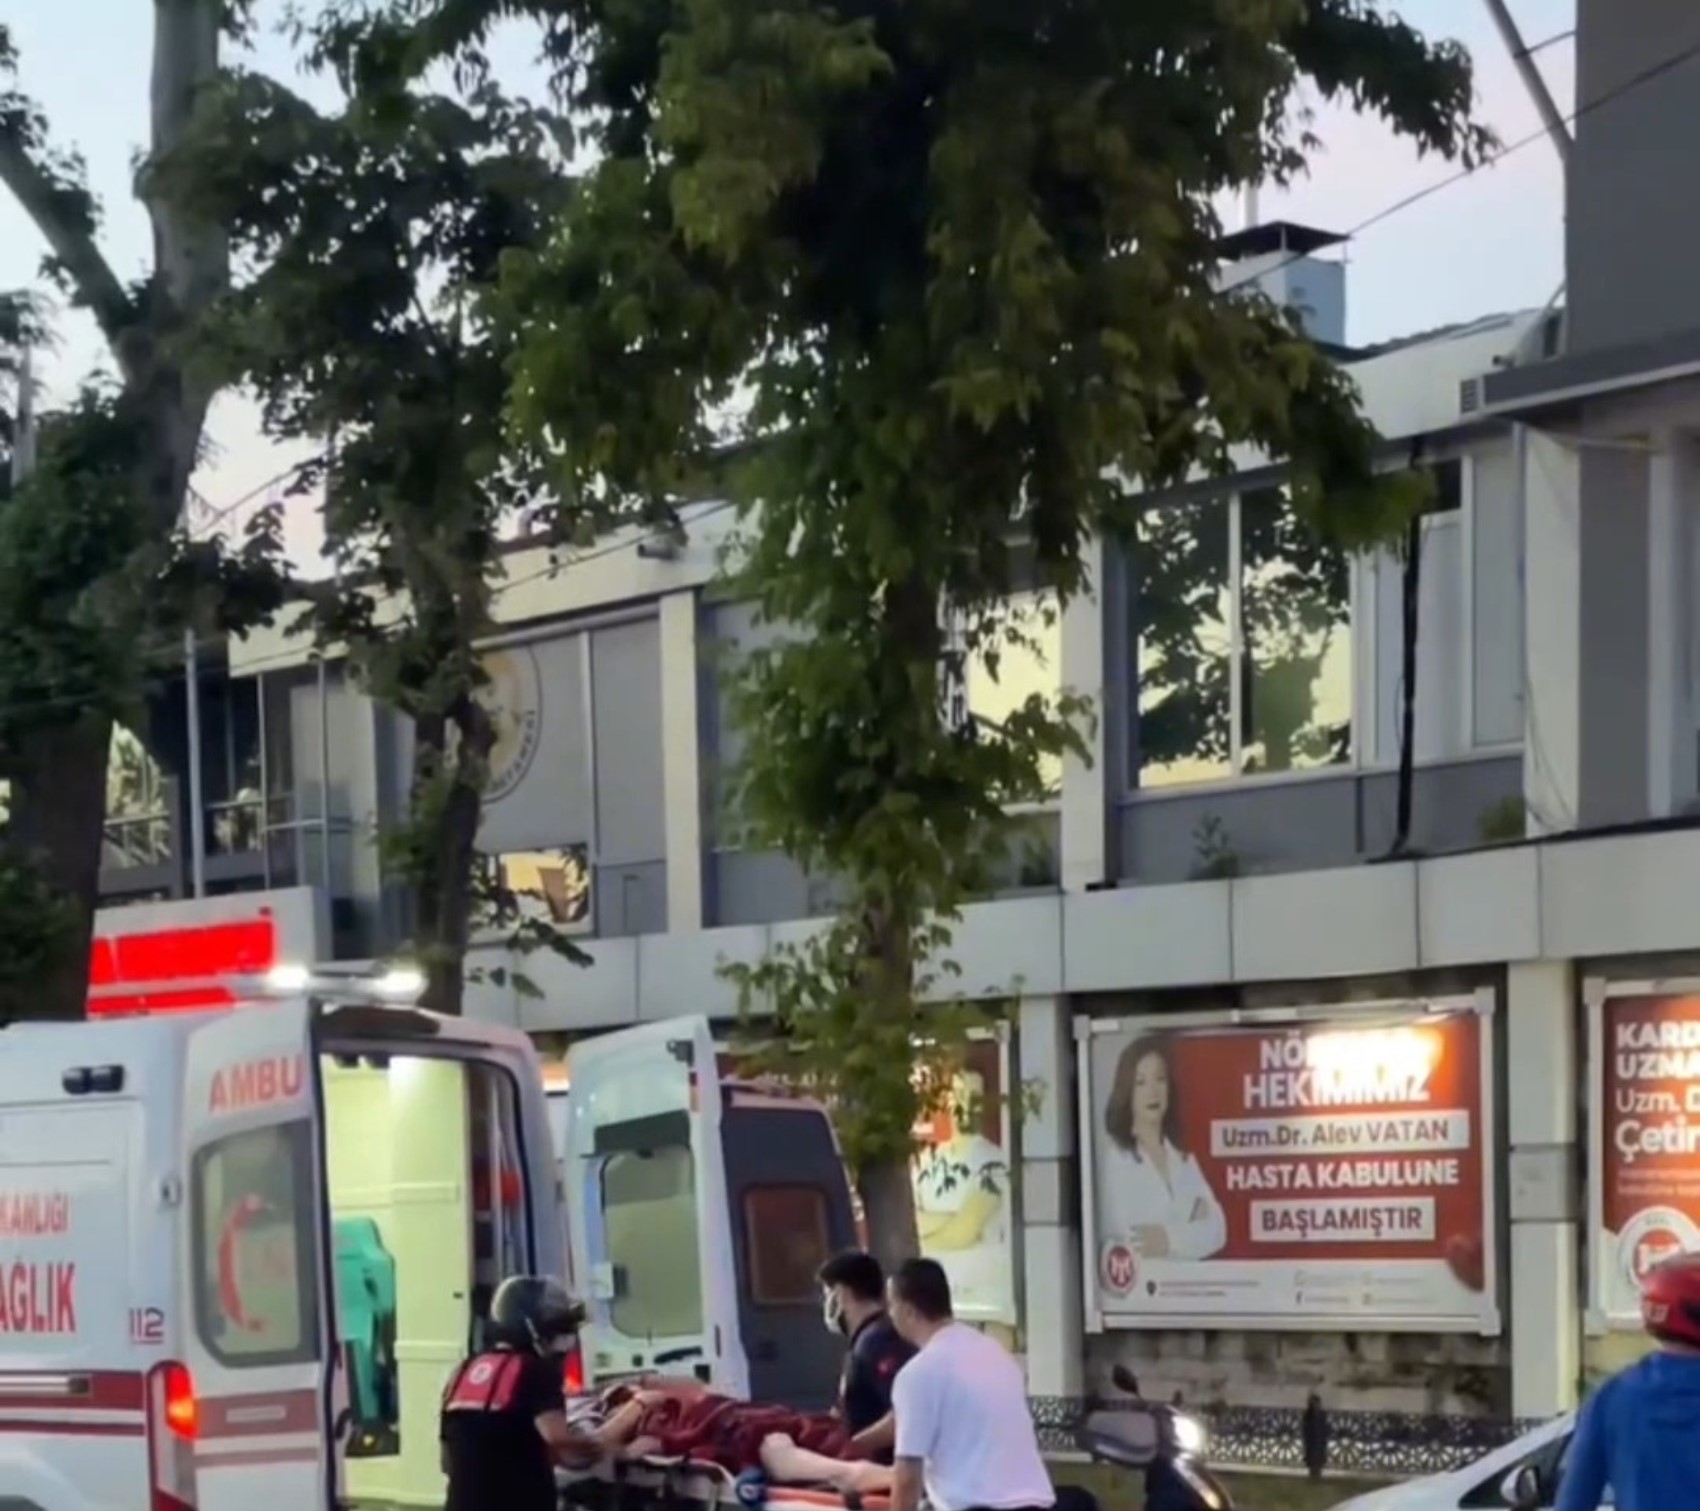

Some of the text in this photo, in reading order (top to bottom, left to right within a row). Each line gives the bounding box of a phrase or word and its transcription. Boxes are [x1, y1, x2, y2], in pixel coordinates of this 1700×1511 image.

[1616, 1088, 1681, 1113] Uzm.
[1312, 1122, 1362, 1145] Alev
[1366, 1119, 1449, 1143] VATAN
[1226, 1164, 1314, 1190] HASTA
[1262, 1206, 1422, 1237] BAŞLAMIŞTIR
[130, 1307, 164, 1338] 112
